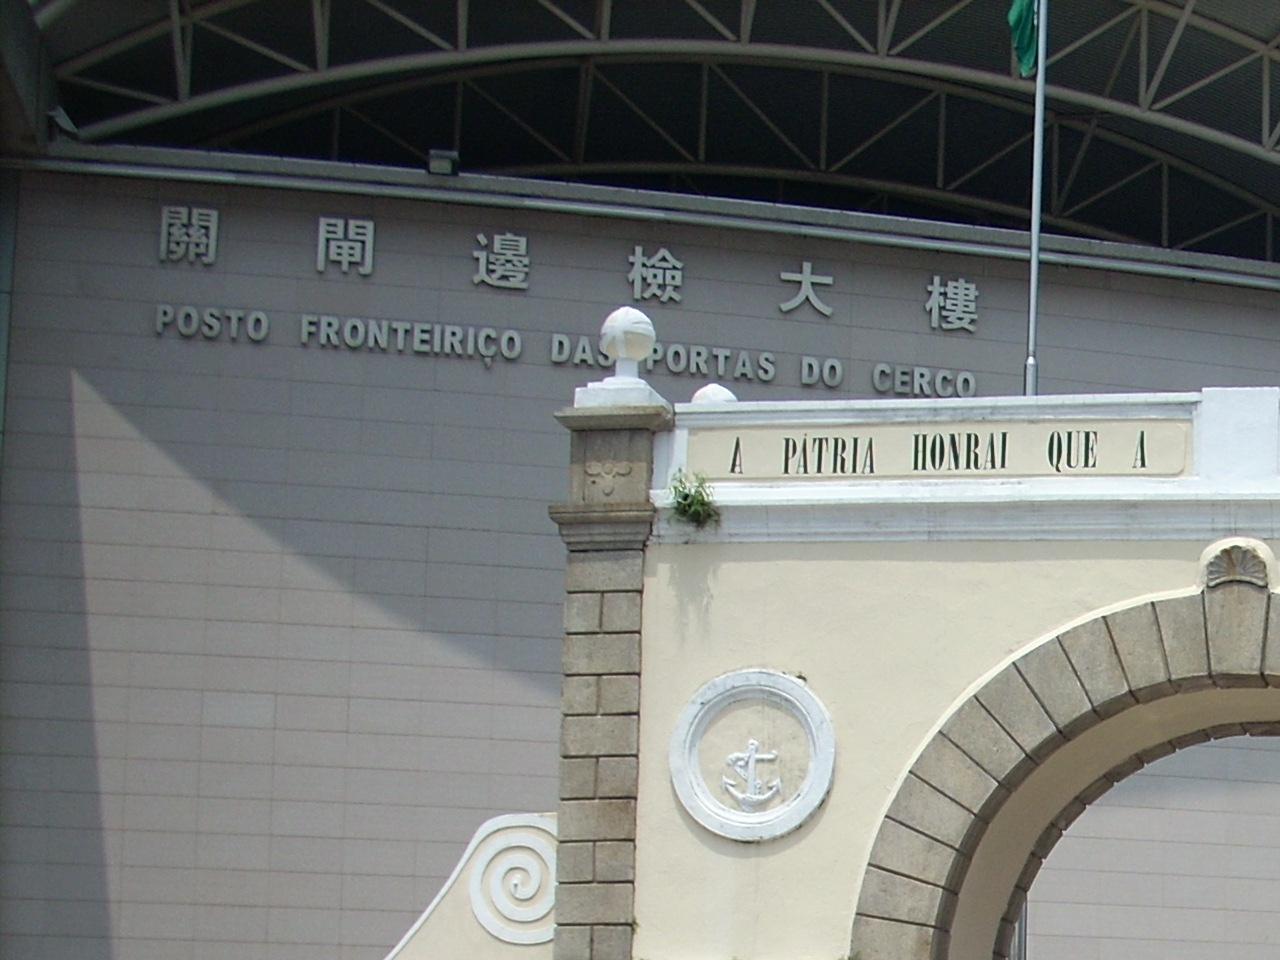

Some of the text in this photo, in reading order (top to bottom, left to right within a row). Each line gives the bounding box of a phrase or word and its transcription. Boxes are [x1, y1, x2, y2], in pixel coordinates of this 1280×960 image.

[158, 204, 979, 333] 關閘邊檢大樓
[155, 304, 269, 342] POSTO
[301, 313, 522, 368] FRONTEIRIÇO
[645, 343, 776, 382] PORTAS
[801, 356, 843, 388] DO
[872, 363, 976, 398] CERCO
[729, 436, 743, 474] A
[912, 431, 1009, 471] HONRAI
[1047, 430, 1099, 472] QUE
[1133, 430, 1147, 469] A
